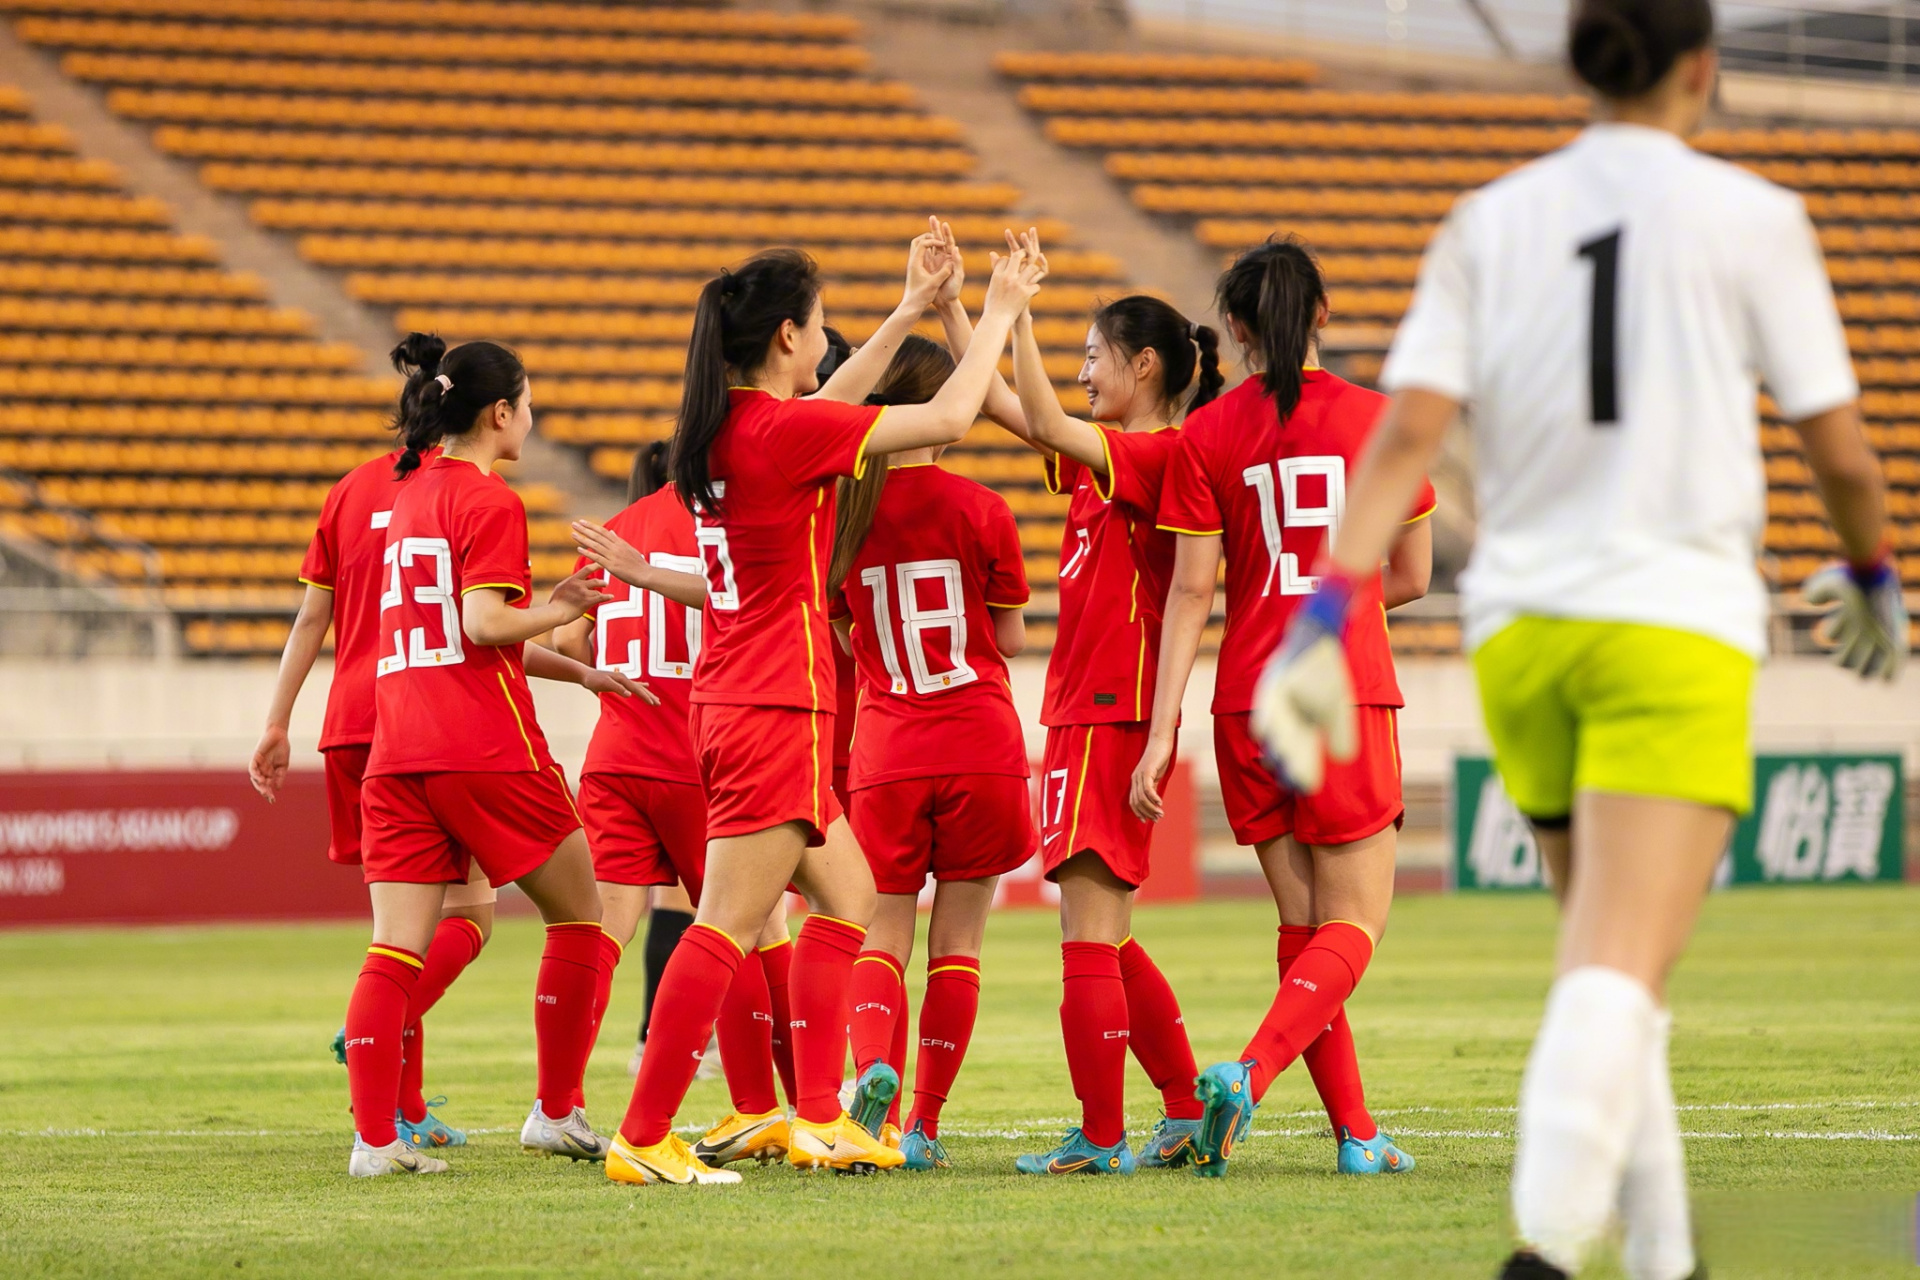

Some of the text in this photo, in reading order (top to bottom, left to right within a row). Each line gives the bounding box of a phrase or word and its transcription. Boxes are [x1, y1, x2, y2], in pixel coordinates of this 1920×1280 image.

[1576, 223, 1623, 425] 1
[1243, 456, 1347, 597] 19
[377, 537, 466, 678] 23
[595, 550, 704, 679] 20
[861, 559, 979, 694] 18
[1043, 768, 1069, 828] 17
[345, 1037, 374, 1050] CFA
[537, 994, 557, 1005] 中国
[856, 1002, 891, 1016] CFA
[921, 1038, 955, 1052] CFA
